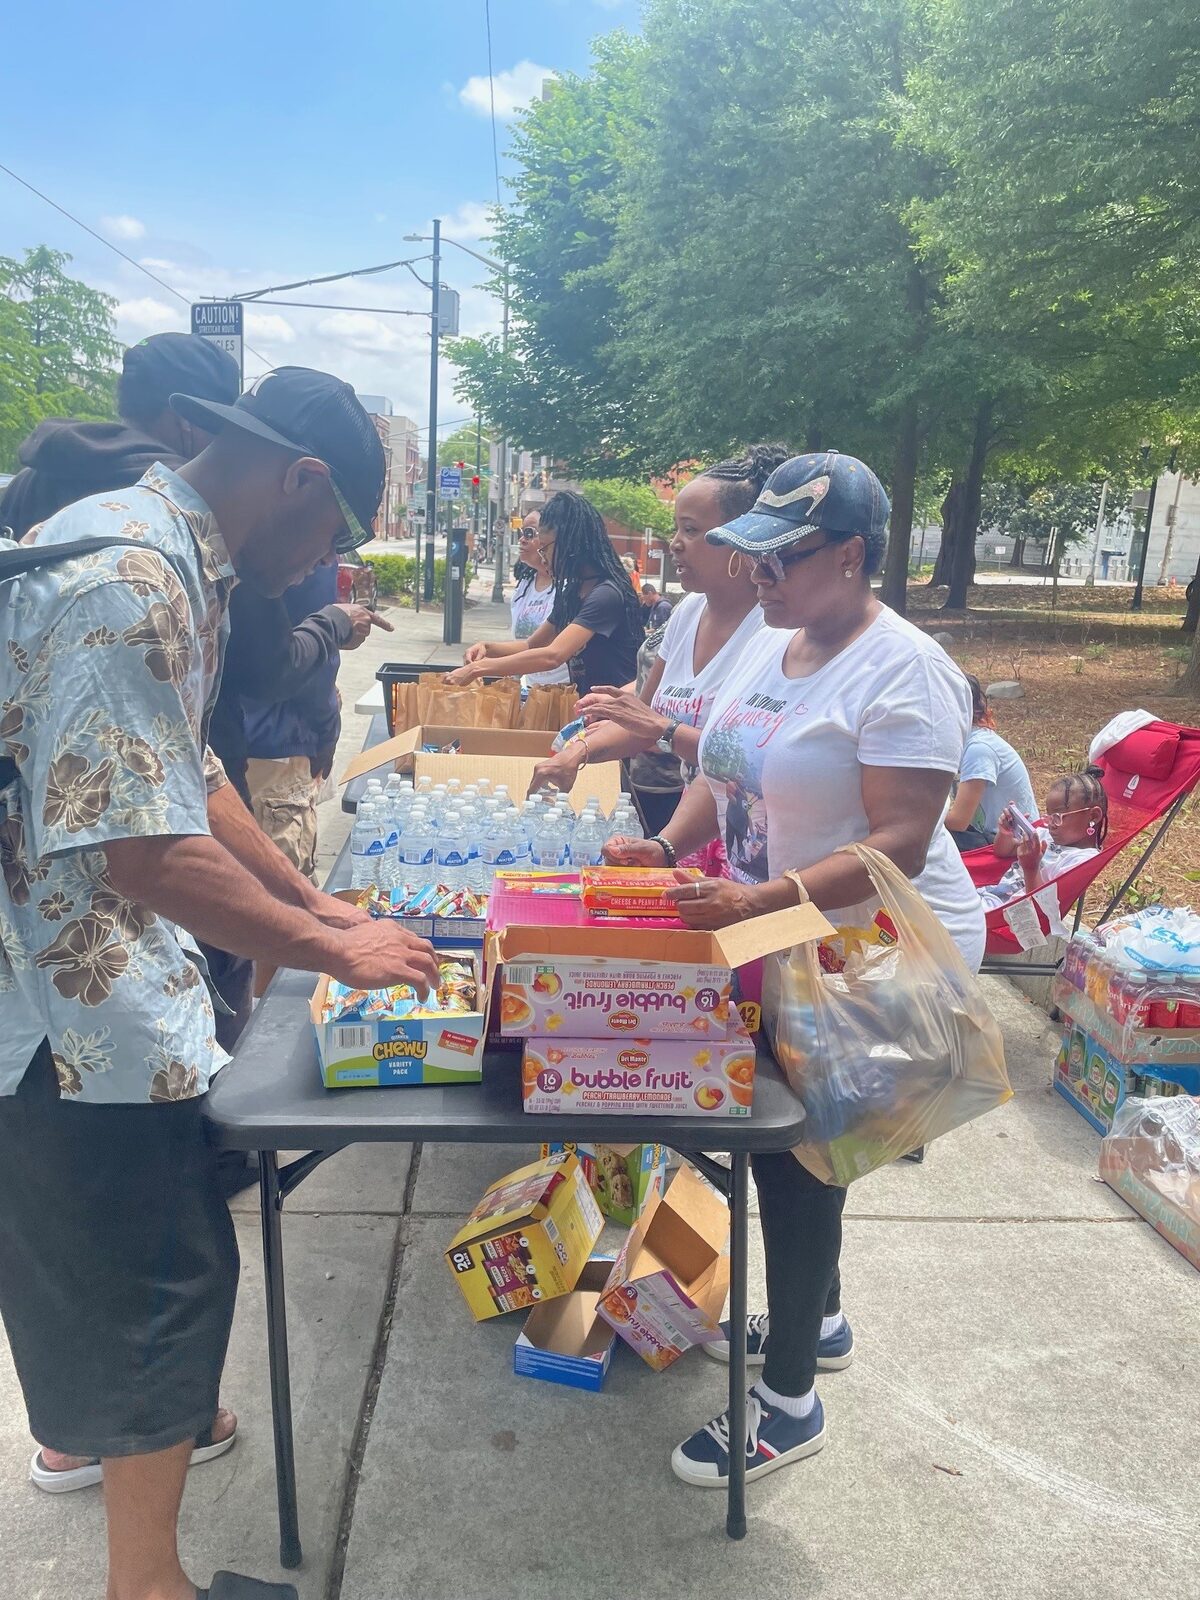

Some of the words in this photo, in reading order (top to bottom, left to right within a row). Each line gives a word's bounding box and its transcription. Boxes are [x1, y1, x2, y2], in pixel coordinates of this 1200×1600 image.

[195, 305, 239, 324] CAUTION!
[663, 685, 672, 697] IN
[671, 685, 695, 698] LOVING
[746, 692, 757, 706] IN
[712, 697, 788, 748] Memory
[610, 898, 632, 907] CHEESE
[638, 900, 659, 908] PEANUT
[585, 979, 616, 989] LEMONADE
[616, 980, 656, 990] STRAWBERRY
[656, 981, 675, 990] PEACH
[563, 991, 612, 1013] fruit
[616, 991, 686, 1014] bubble
[701, 996, 714, 1008] 16
[388, 1061, 412, 1069] VARIETY
[392, 1068, 408, 1076] PACK
[571, 1066, 642, 1090] bubble
[645, 1067, 694, 1090] fruit
[543, 1073, 557, 1086] 16
[583, 1091, 602, 1100] PEACH
[602, 1091, 641, 1101] STRAWBERRY
[640, 1092, 672, 1101] LEMONADE
[453, 1252, 467, 1271] 20
[500, 1265, 511, 1284] PIECES
[626, 1288, 635, 1298] 16
[622, 1310, 641, 1330] fruit
[638, 1326, 665, 1352] bubble
